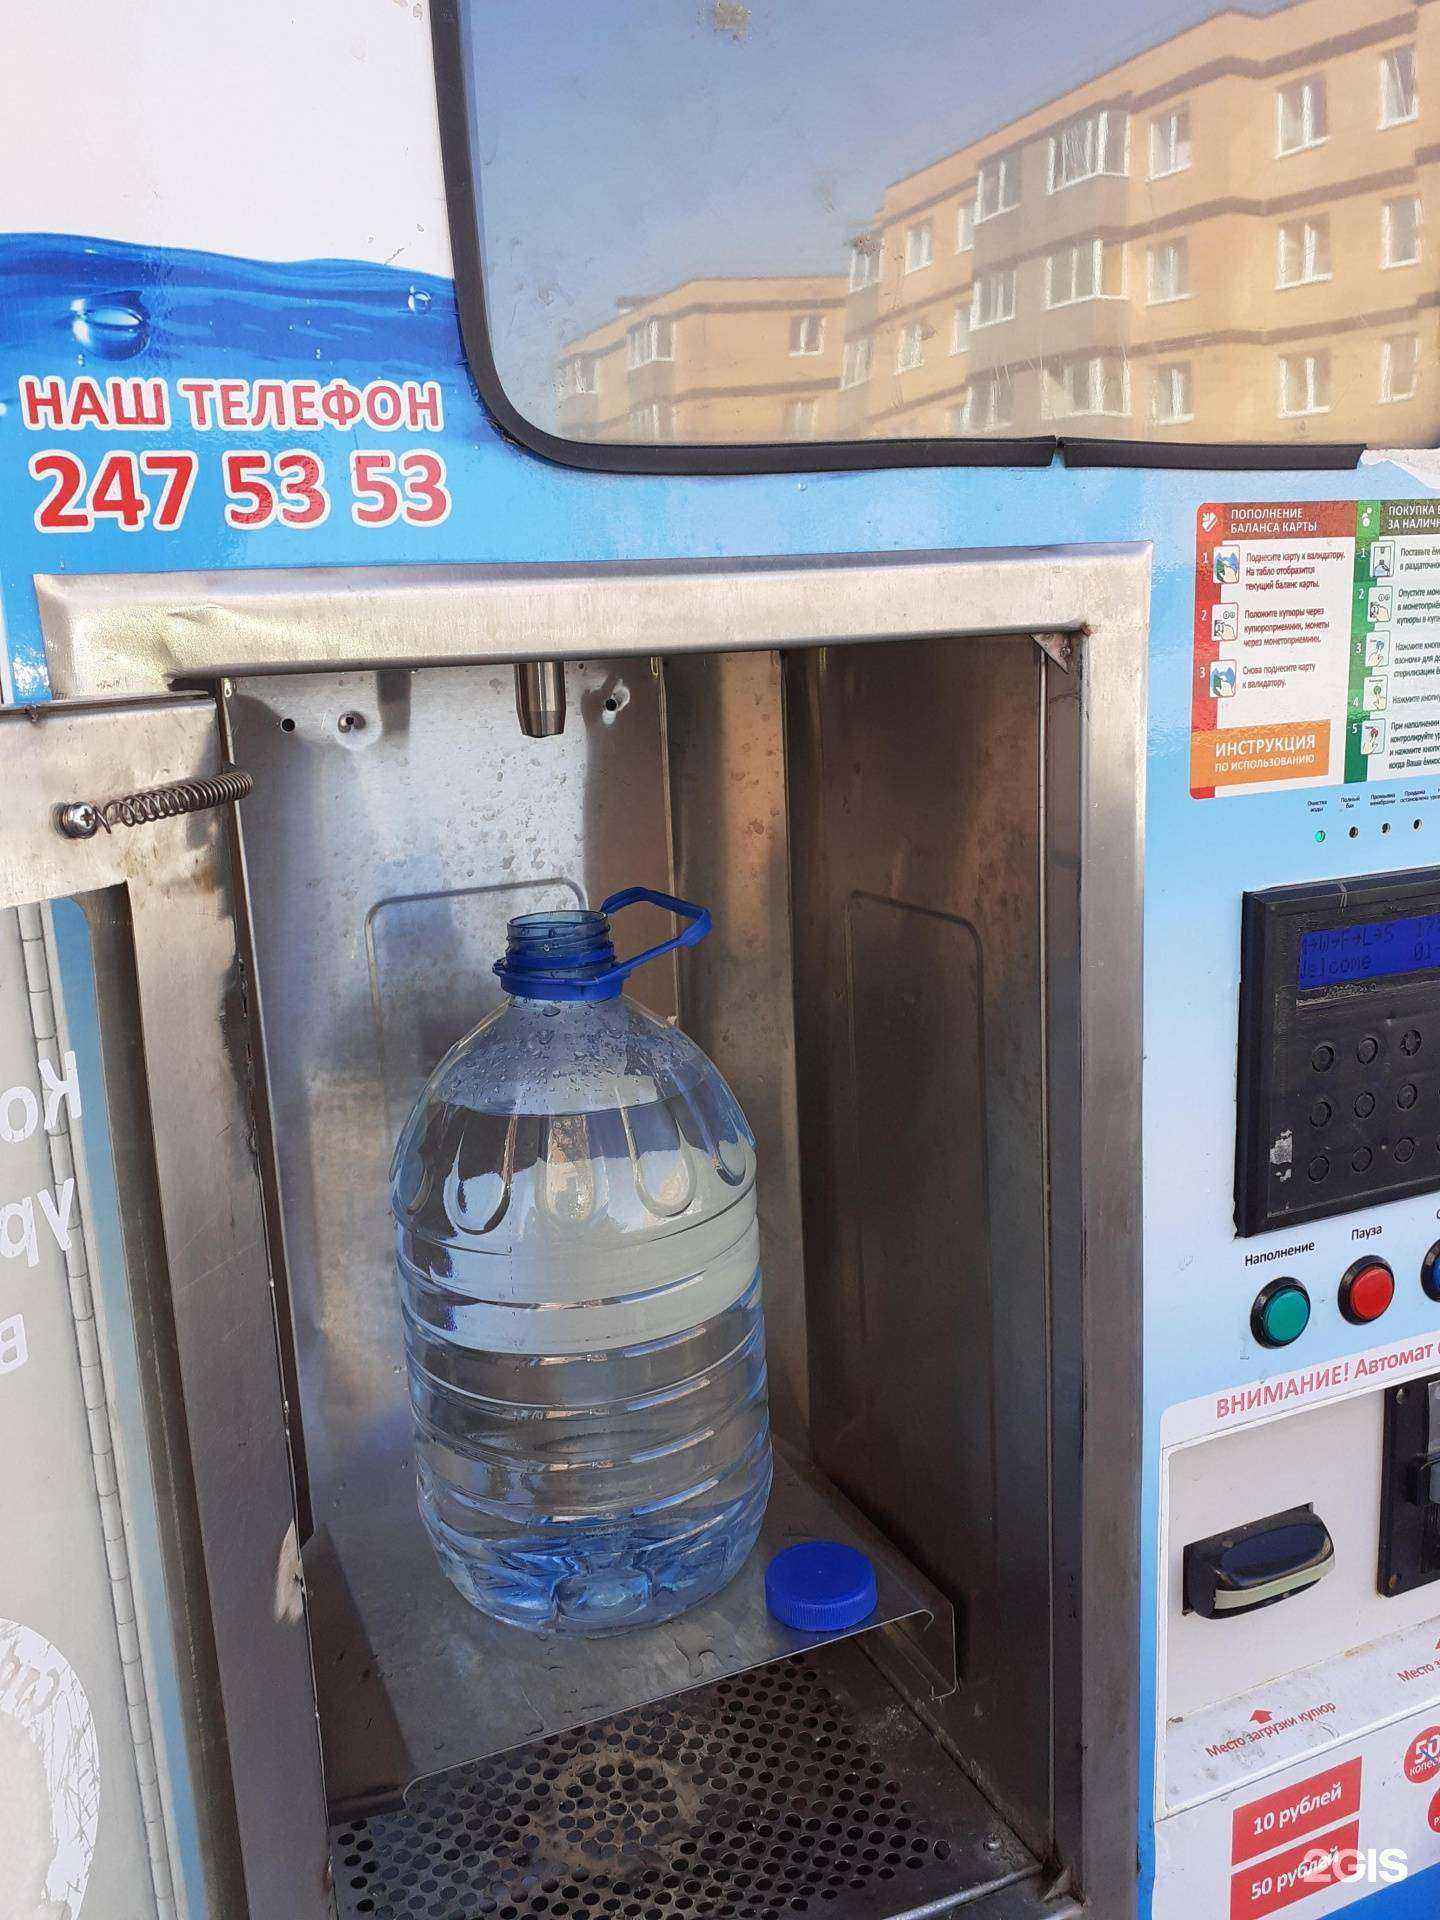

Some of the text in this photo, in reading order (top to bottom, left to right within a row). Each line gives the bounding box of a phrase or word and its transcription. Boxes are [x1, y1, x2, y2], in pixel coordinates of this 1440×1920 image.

[22, 378, 441, 428] НАШ ТЕЛЕФОН
[31, 453, 449, 530] 247 53 53
[1231, 508, 1303, 520] ПОПОЛНЕНИЕ
[1389, 505, 1435, 516] ПОКУПКА
[1230, 522, 1318, 534] БАЛАНСА КАРТЫ
[1388, 519, 1400, 530] ЗА
[1351, 723, 1358, 734] 5
[1215, 735, 1316, 757] ИНСТРУКЦИЯ
[1231, 754, 1315, 771] ИСПОЛЬЗОВАНИЮ
[1351, 1224, 1383, 1241] Пауза
[1244, 1241, 1315, 1267] Наполнение
[1215, 1343, 1434, 1419] ВНИМАНИЕ! Автомат
[1396, 1664, 1435, 1682] Место
[1204, 1701, 1337, 1759] Место загрузки купюр
[1252, 1781, 1344, 1836] 10 рублей
[1250, 1879, 1273, 1901] 50
